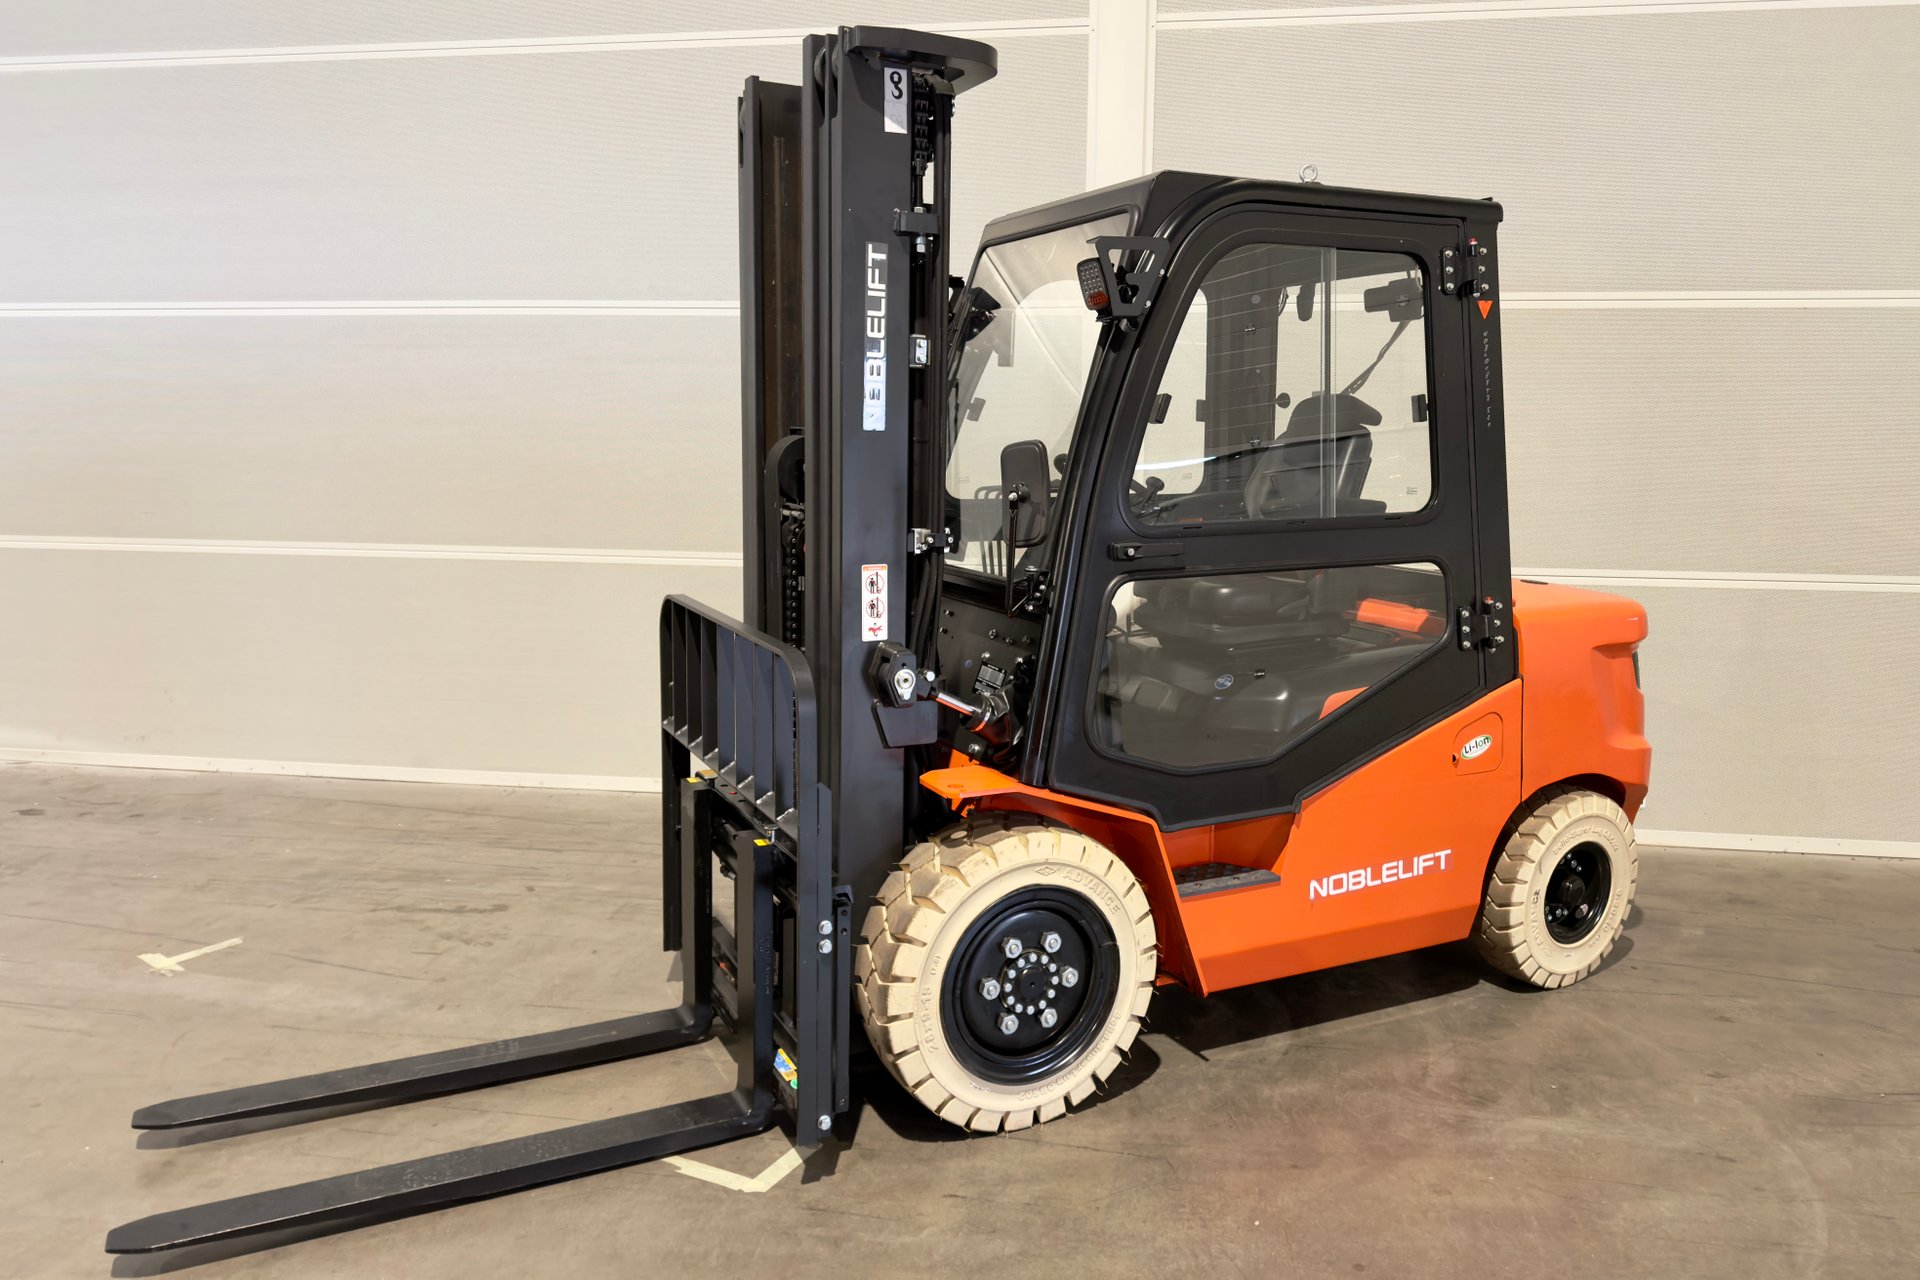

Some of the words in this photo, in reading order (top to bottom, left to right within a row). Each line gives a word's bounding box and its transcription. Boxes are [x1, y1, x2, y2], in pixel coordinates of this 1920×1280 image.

[864, 243, 887, 431] BLELIFT
[1464, 736, 1490, 754] Li-Ion
[1063, 868, 1121, 915] ADVANCE
[1309, 849, 1452, 900] NOBLELIFT
